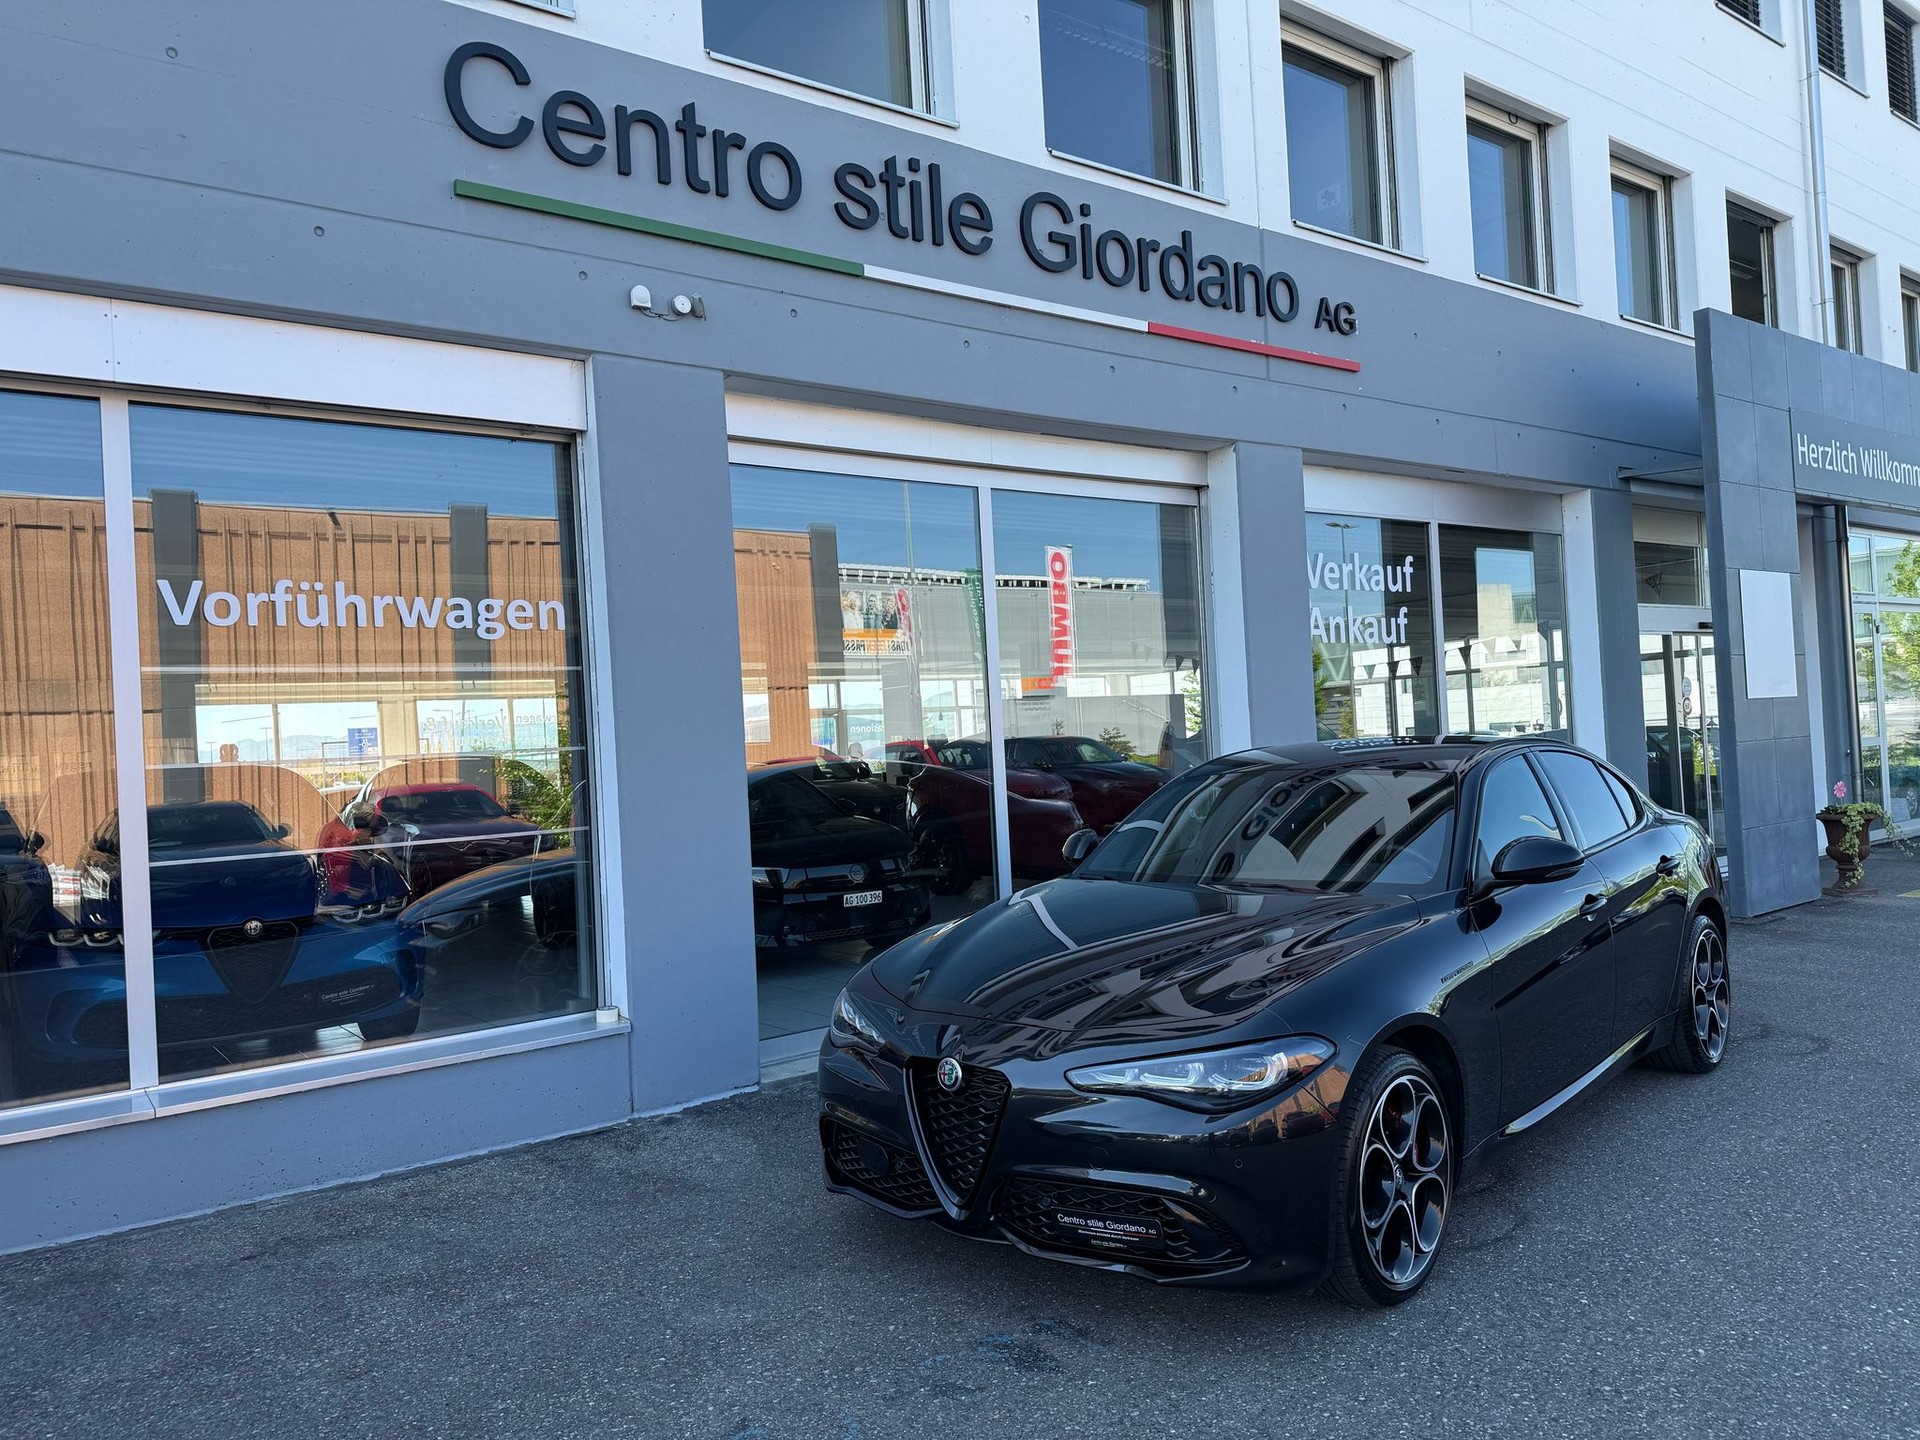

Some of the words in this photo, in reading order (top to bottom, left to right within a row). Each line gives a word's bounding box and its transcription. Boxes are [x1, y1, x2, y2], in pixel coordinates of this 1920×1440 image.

[443, 41, 802, 212] Centro
[833, 155, 994, 256] stile
[1019, 191, 1299, 323] Giordano
[1314, 296, 1357, 336] AG
[1797, 432, 1858, 475] Herzlich
[1306, 552, 1414, 593] Verkauf
[157, 579, 566, 640] Vorführwagen
[1310, 606, 1408, 644] Ankauf
[845, 895, 854, 906] AG
[855, 894, 868, 905] 100
[869, 892, 882, 903] 396
[1057, 1213, 1085, 1225] Centro
[1106, 1220, 1146, 1233] Giordano
